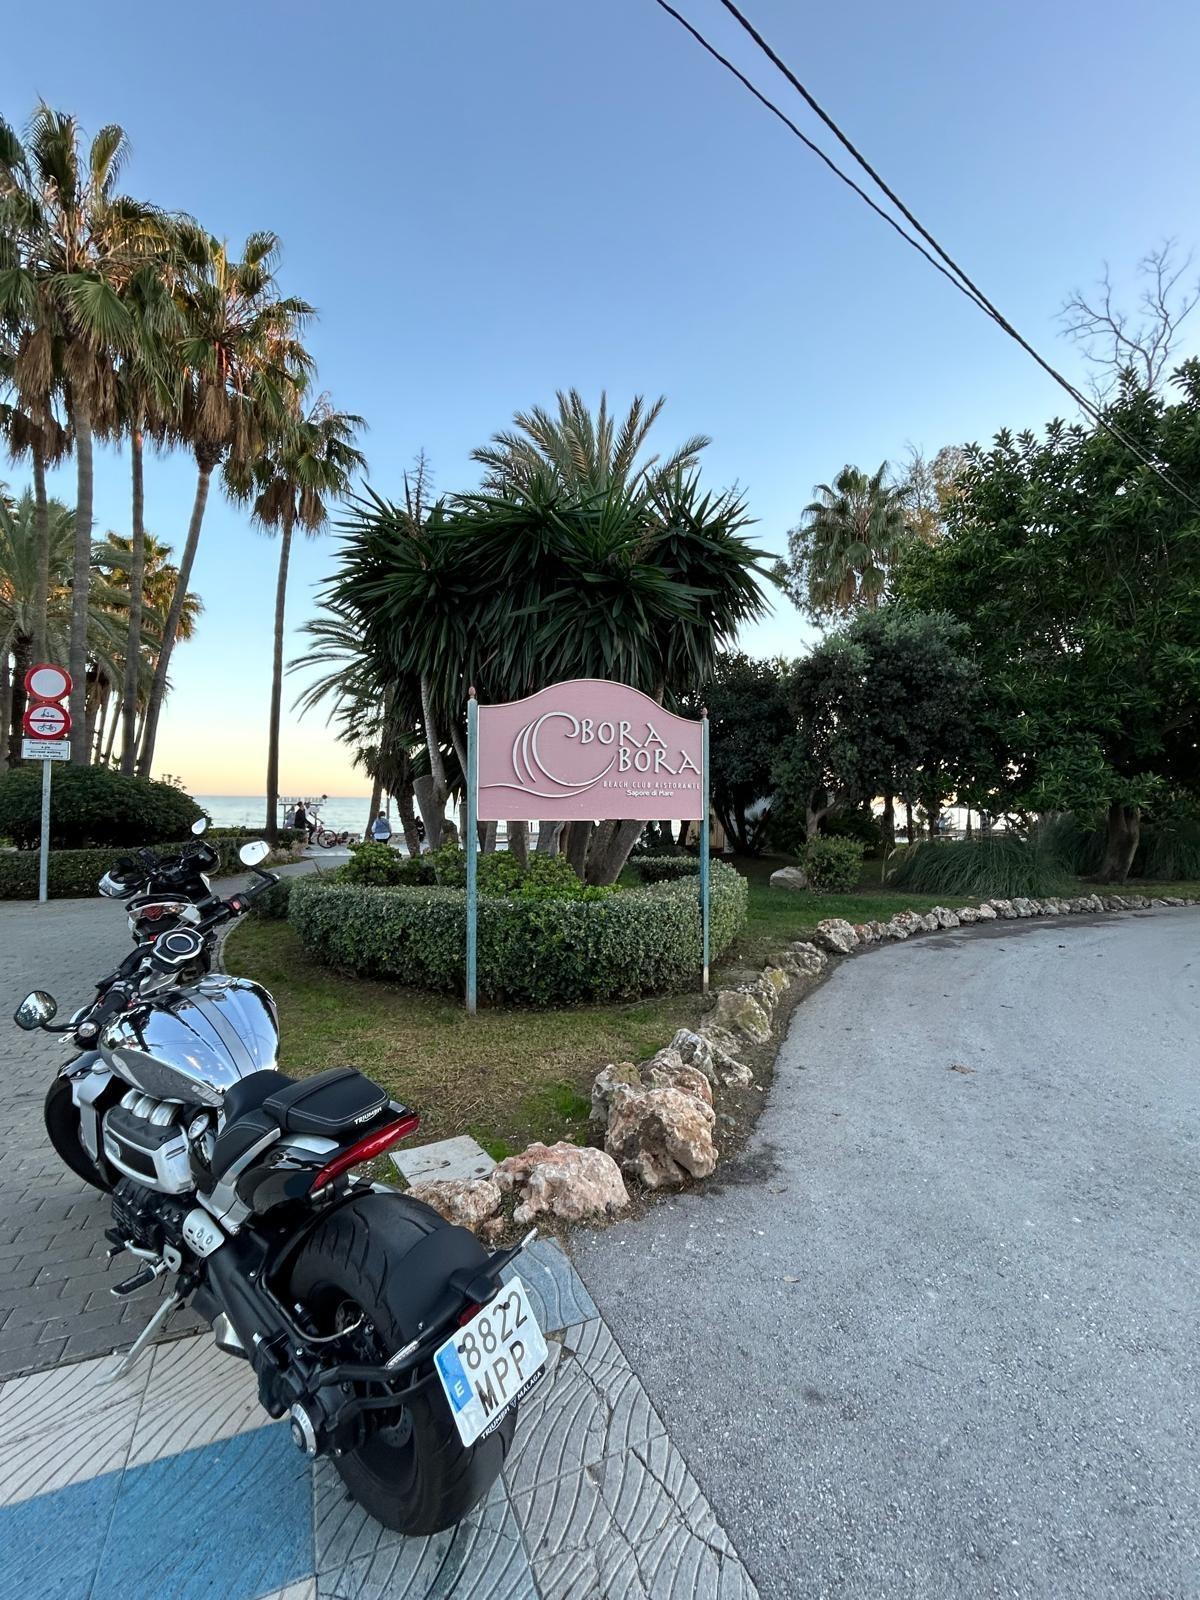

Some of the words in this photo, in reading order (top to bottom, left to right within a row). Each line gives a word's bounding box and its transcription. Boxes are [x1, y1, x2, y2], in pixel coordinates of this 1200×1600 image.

[581, 718, 668, 748] BORA
[618, 747, 701, 775] BORA
[603, 780, 628, 788] BEACH
[632, 781, 651, 789] CLUB
[655, 781, 700, 790] RISTORANTE
[626, 789, 650, 798] Sapore
[650, 789, 657, 797] di
[353, 1105, 382, 1125] TRIUMPH
[461, 1290, 528, 1370] 8822
[453, 1379, 465, 1398] E
[475, 1340, 525, 1418] MPP
[480, 1406, 510, 1440] TRIUMPH
